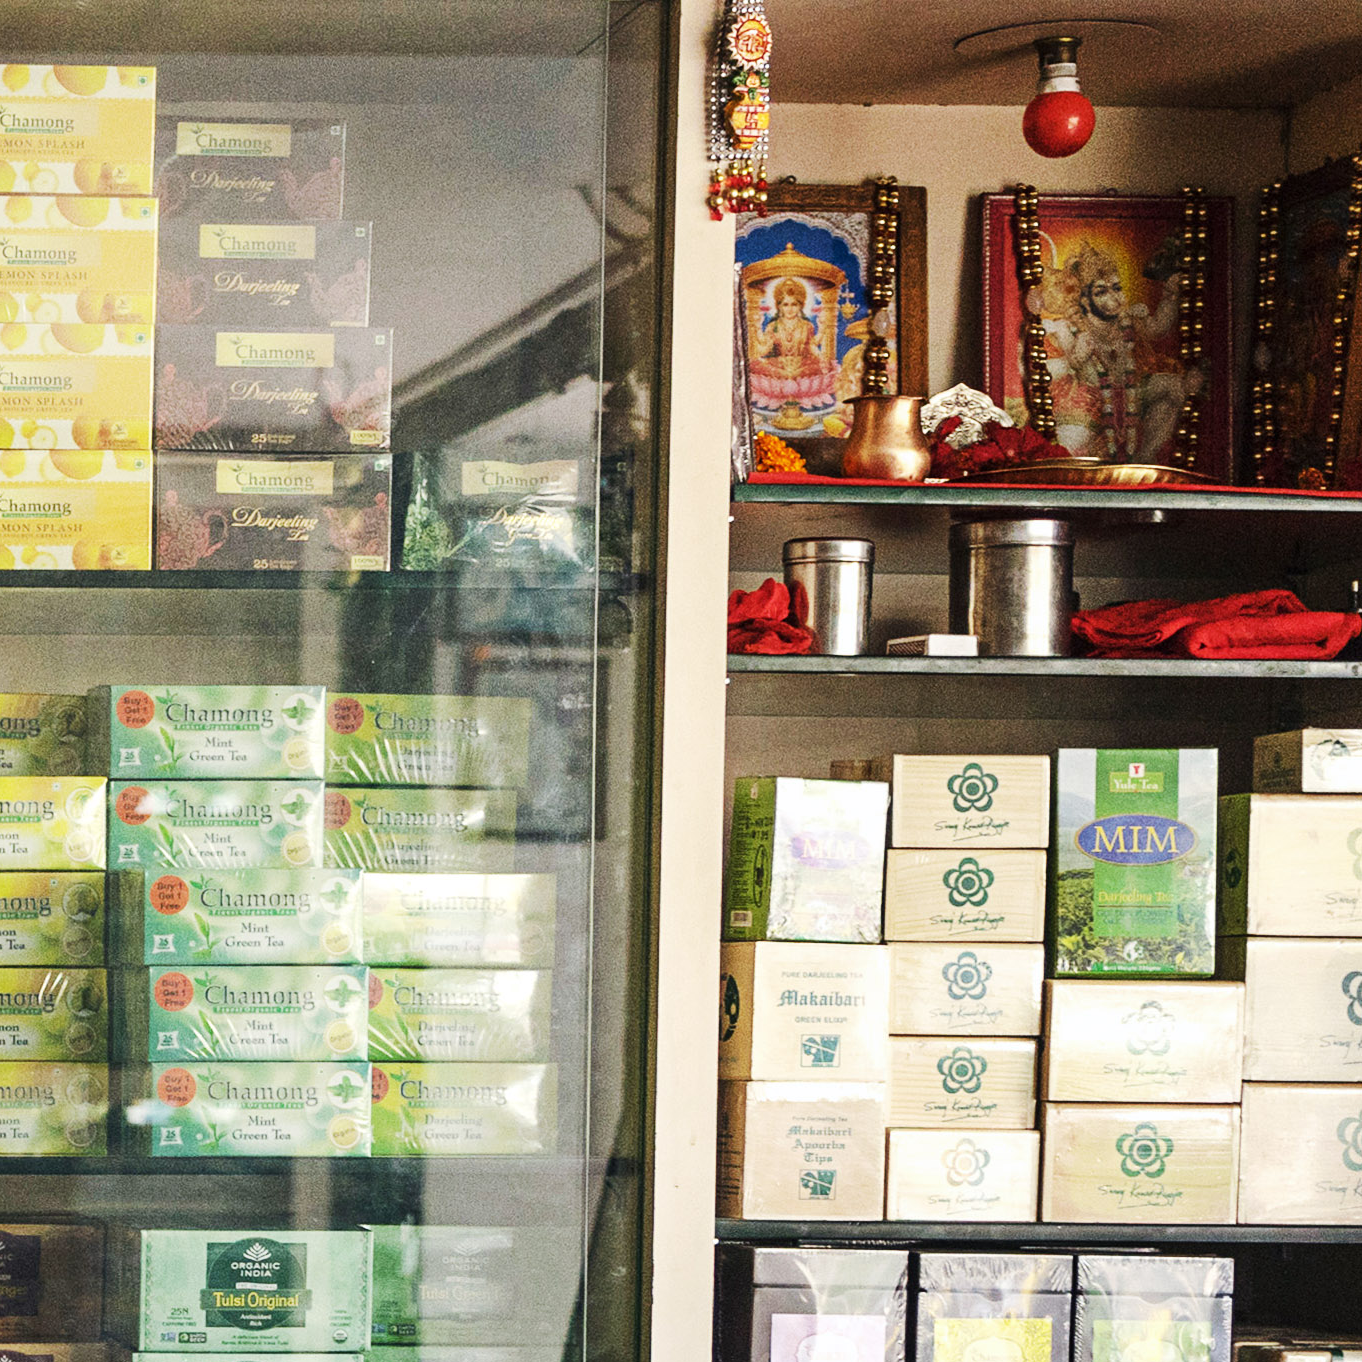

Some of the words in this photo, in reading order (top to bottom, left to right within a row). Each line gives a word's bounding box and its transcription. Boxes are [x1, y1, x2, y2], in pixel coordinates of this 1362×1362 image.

[232, 507, 318, 532] Darjeeling
[34, 522, 83, 533] SPLASH
[1114, 780, 1139, 792] Yule
[1143, 780, 1159, 792] Tea
[1093, 826, 1178, 853] MIM
[9, 844, 28, 853] Tea
[201, 887, 310, 911] Chamong
[241, 923, 269, 933] Mint
[225, 936, 258, 948] Green
[261, 936, 284, 947] Tea
[778, 990, 865, 1007] Makaibari
[213, 1293, 244, 1307] Tulsi
[247, 1293, 299, 1309] Original
